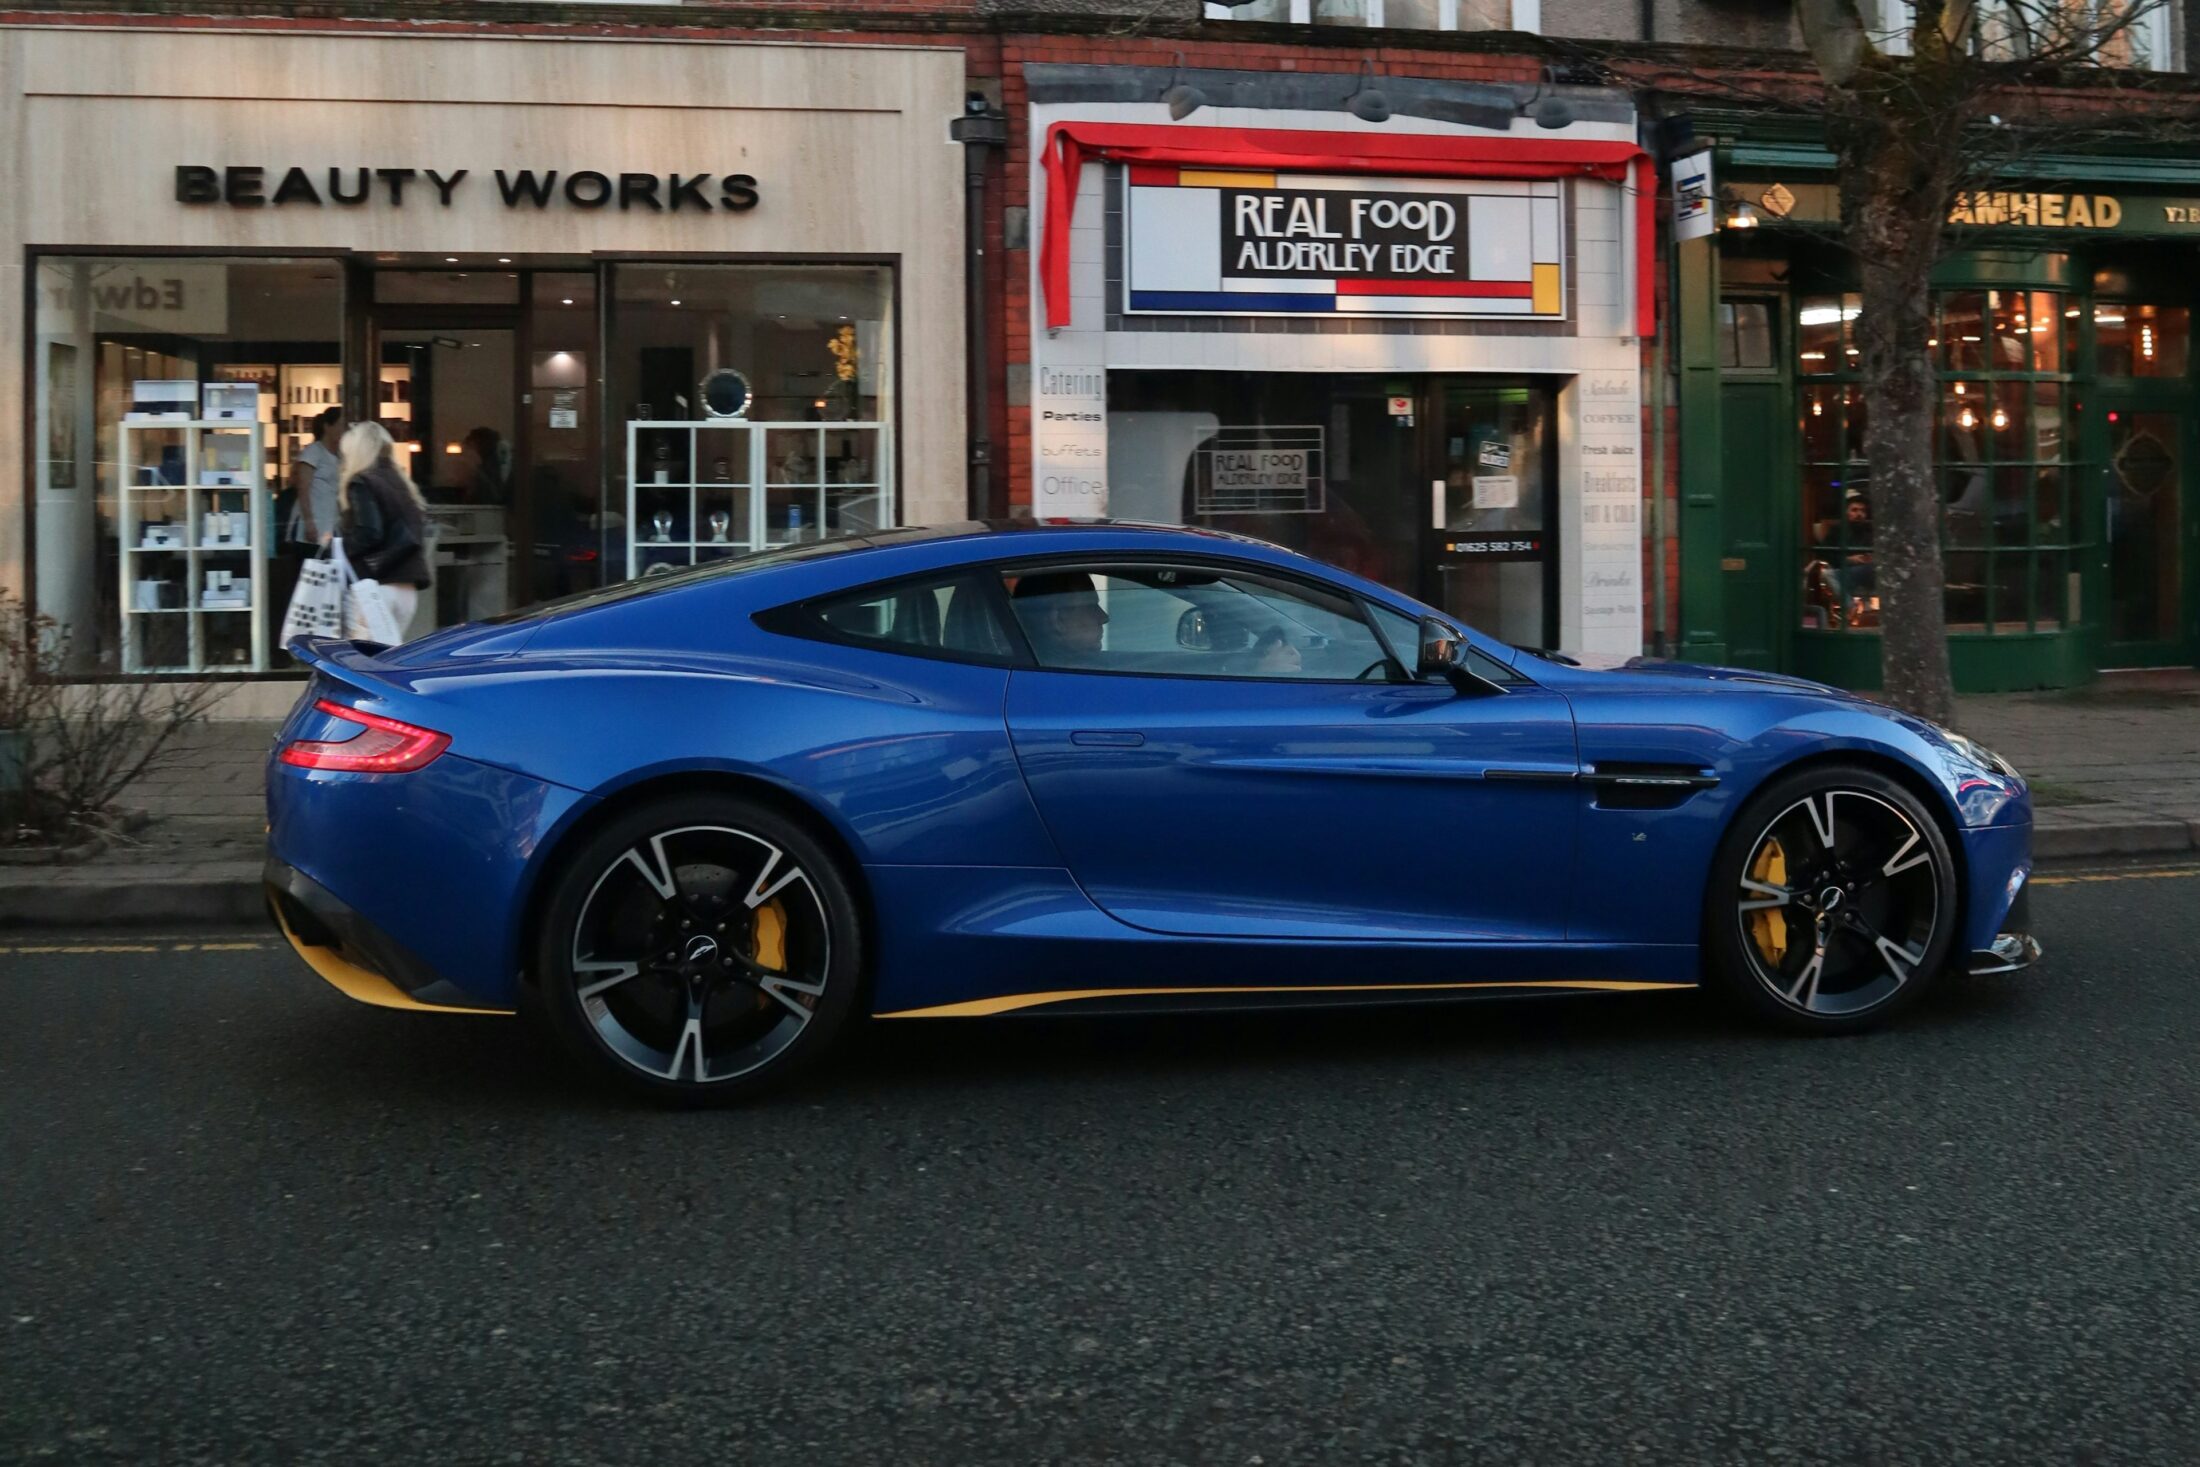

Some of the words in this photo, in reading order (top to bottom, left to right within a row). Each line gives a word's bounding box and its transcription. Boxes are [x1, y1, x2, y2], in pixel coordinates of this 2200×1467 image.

[175, 164, 469, 206] BEAUTY
[493, 169, 762, 212] WORKS
[1234, 194, 1343, 238] REAL
[1350, 199, 1456, 242] FOOD
[1236, 241, 1380, 272] ALDERLEY
[1390, 243, 1455, 273] EDGE
[1041, 366, 1101, 401] Catering
[1043, 411, 1102, 422] Parties
[1583, 414, 1636, 424] COFFEE
[1041, 444, 1102, 456] buffets
[1216, 454, 1257, 472] REAL
[1260, 453, 1303, 471] FOOD
[1042, 476, 1103, 496] Office
[1489, 541, 1510, 552] 582
[1511, 541, 1532, 551] 754
